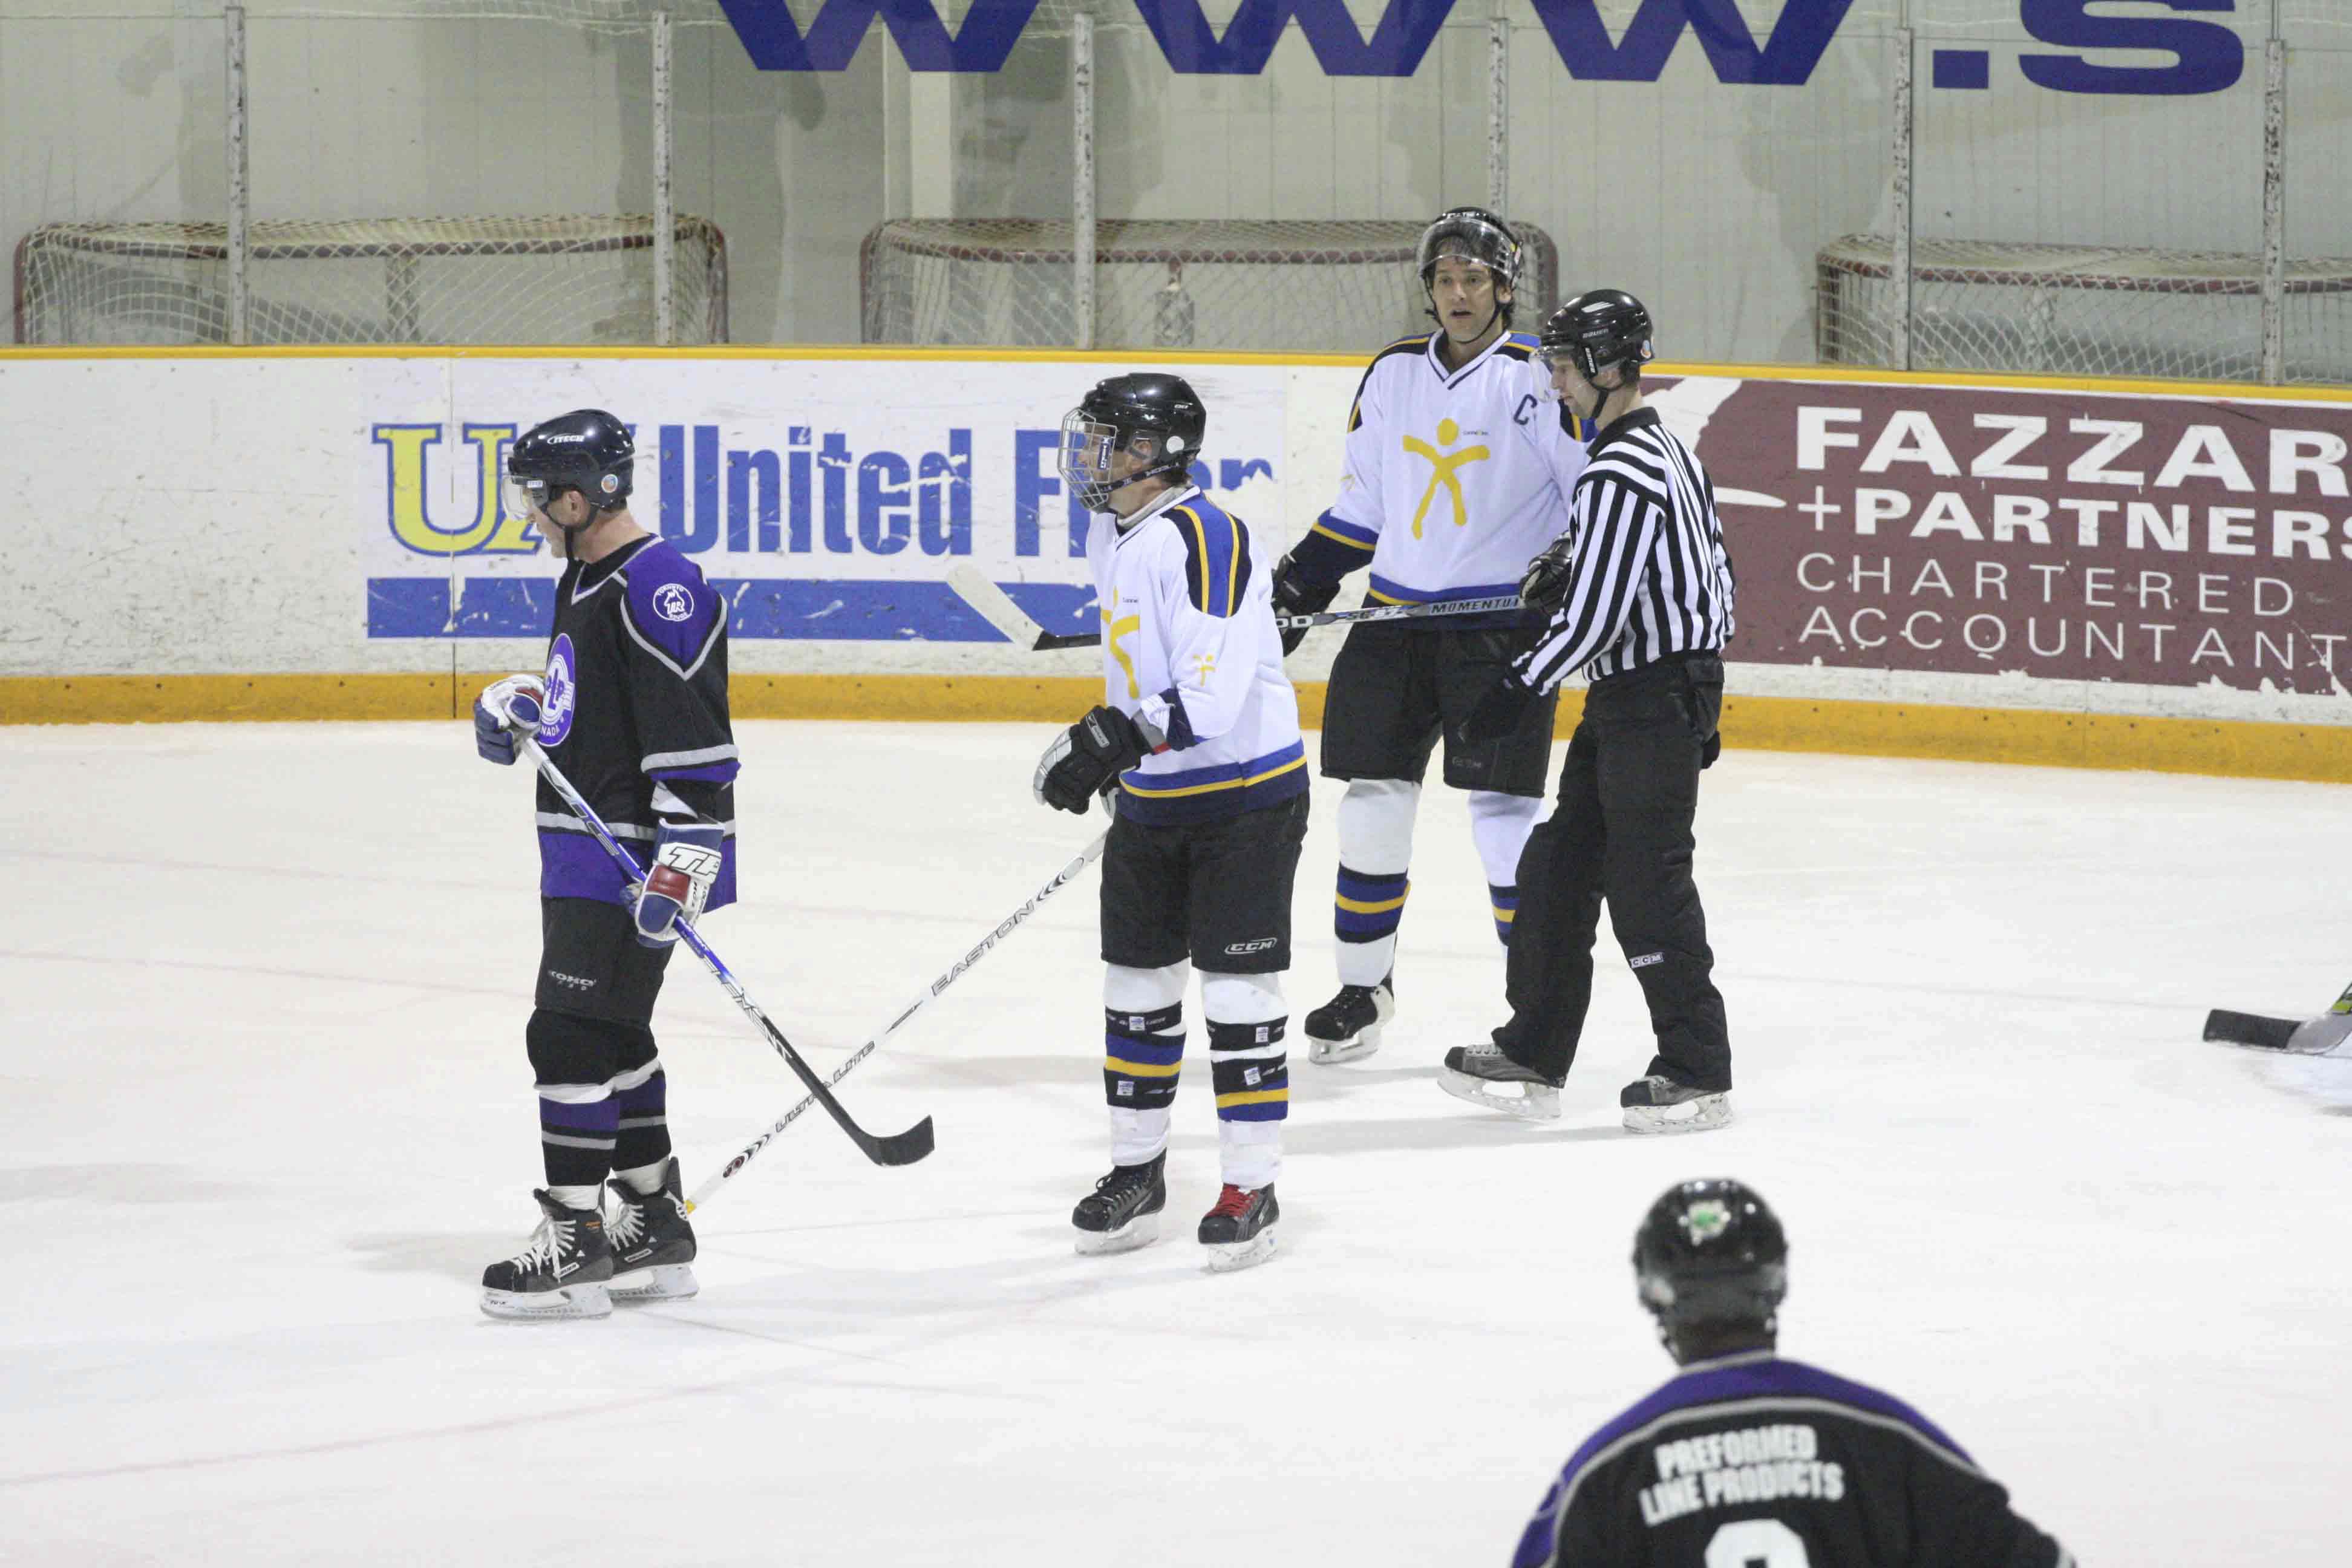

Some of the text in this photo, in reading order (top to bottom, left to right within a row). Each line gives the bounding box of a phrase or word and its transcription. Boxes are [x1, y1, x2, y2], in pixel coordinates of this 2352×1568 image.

[1514, 394, 1537, 425] C
[1797, 406, 2350, 497] FAZZAR
[659, 425, 972, 555] United
[1431, 597, 1520, 613] MOMENTU
[1797, 552, 2293, 617] CHARTERED
[1798, 606, 2347, 672] ACCOUNTANT
[932, 899, 1035, 997] EASTON
[1227, 939, 1275, 953] CCM
[1654, 1424, 1817, 1480] PREFORMED
[1639, 1460, 1844, 1527] LINE PRODUCTS
